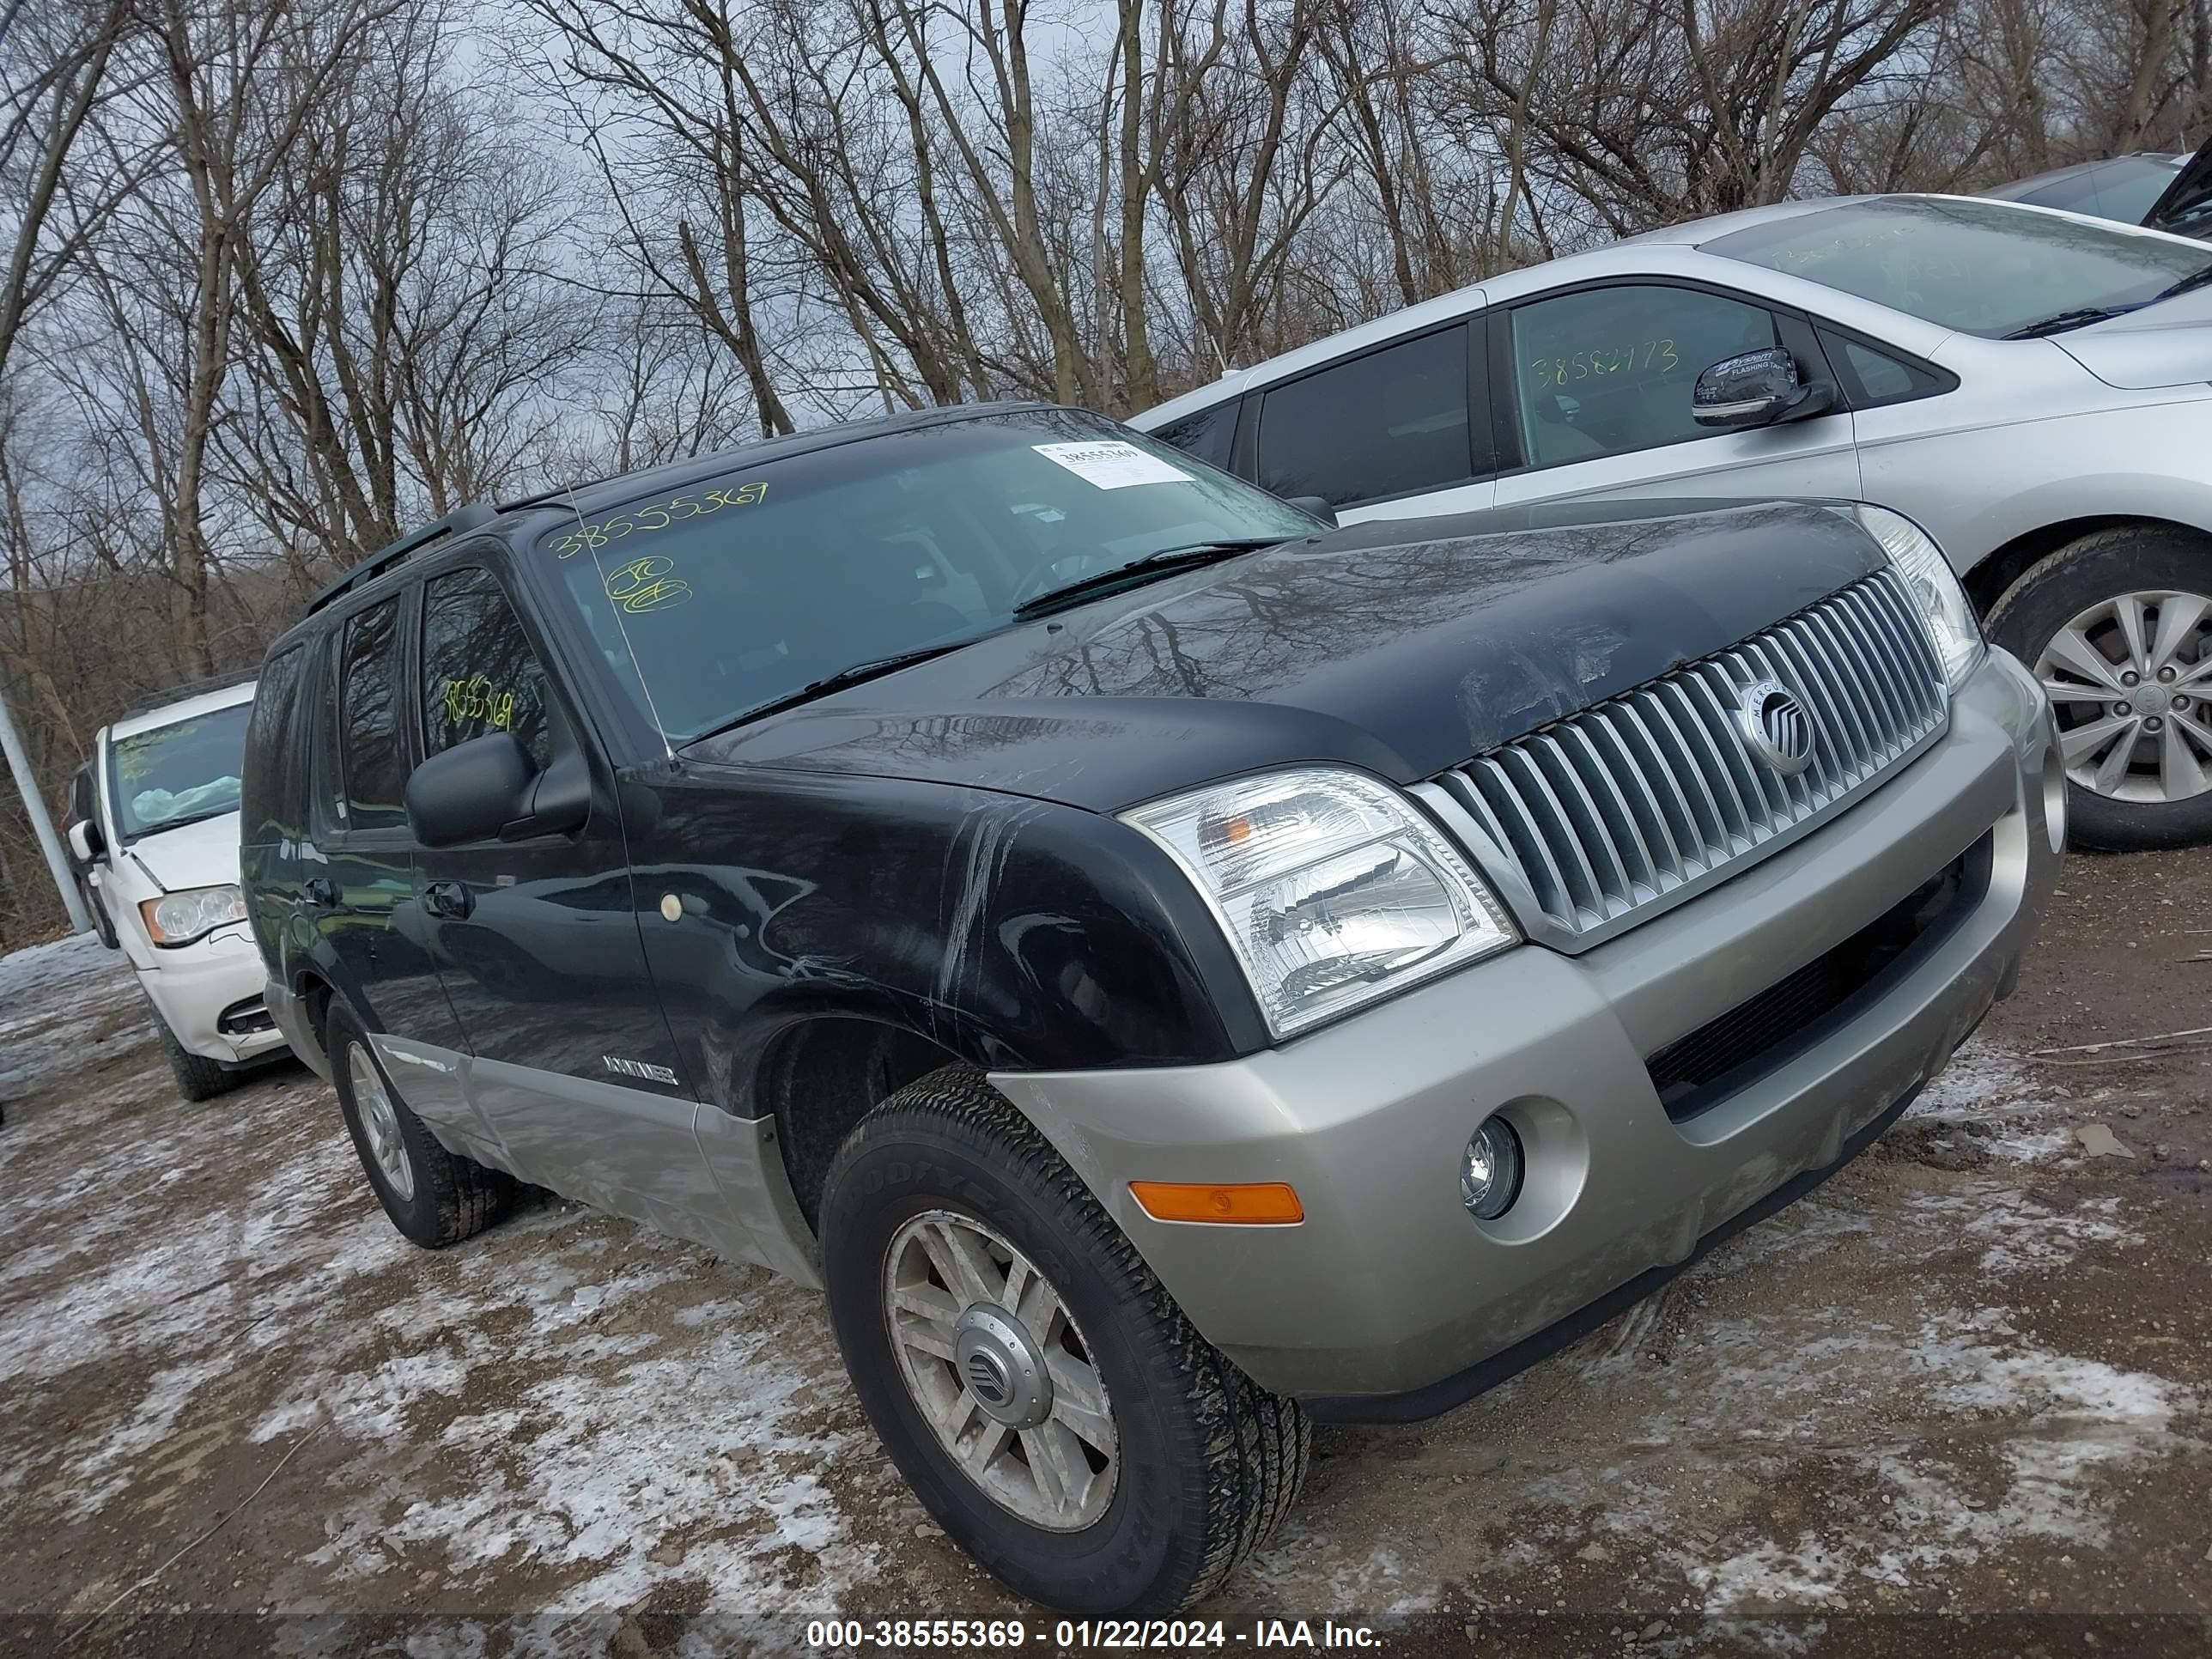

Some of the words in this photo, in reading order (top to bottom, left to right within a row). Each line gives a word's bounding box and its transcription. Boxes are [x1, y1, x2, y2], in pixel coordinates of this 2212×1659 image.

[1731, 361, 1769, 376] FLASHING
[1059, 449, 1139, 464] 38555369
[548, 482, 769, 560] 38555369
[445, 674, 514, 732] 38555369
[1753, 683, 1796, 720] MERCUR
